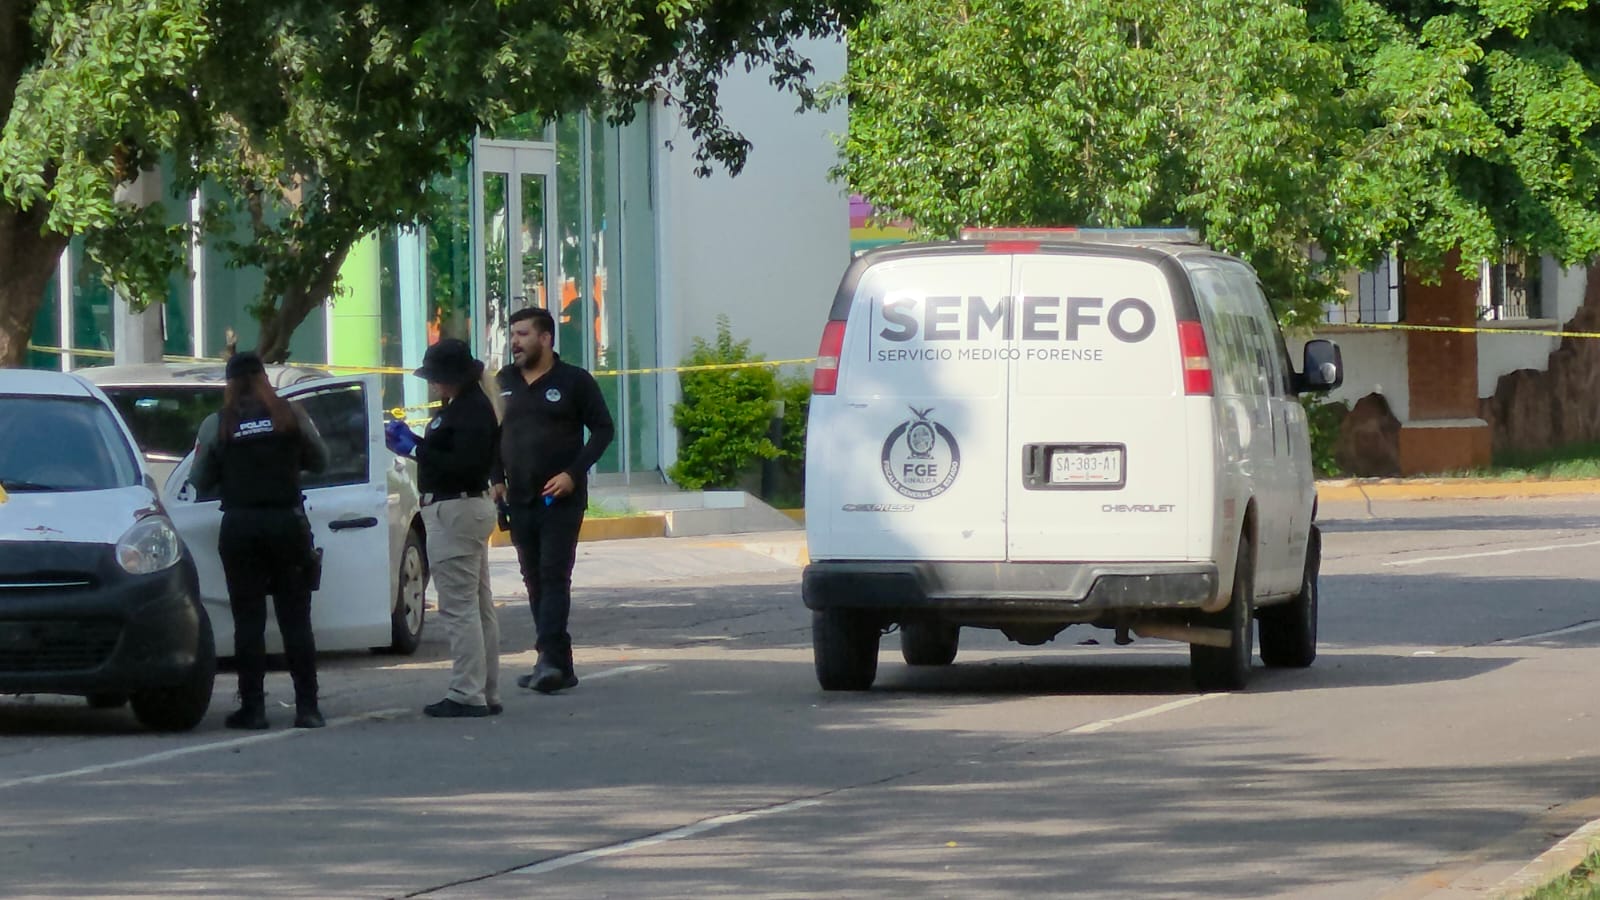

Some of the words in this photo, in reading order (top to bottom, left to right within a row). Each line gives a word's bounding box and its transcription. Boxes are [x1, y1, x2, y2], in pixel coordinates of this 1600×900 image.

[879, 296, 1156, 343] SEMEFO
[878, 349, 953, 361] SERVICIO
[958, 349, 1020, 361] MEDICO
[1026, 349, 1103, 361] FORENSE
[903, 463, 937, 477] FGE
[1102, 504, 1176, 512] CHEVROLET
